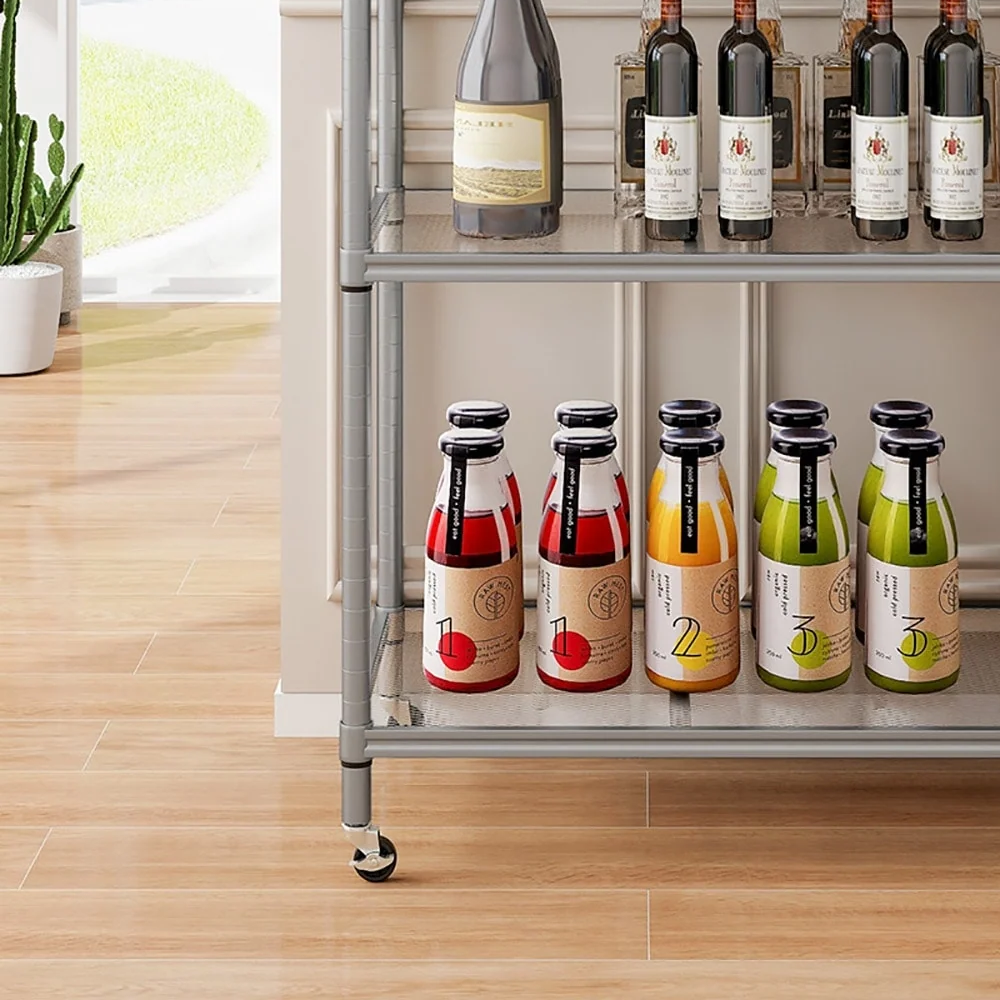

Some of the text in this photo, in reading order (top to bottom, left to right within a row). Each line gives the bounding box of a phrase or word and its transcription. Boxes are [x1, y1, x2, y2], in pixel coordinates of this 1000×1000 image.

[436, 617, 457, 658] 1
[550, 616, 572, 657] 1
[671, 616, 702, 657] 2
[787, 615, 817, 655] 3
[896, 616, 927, 657] 3
